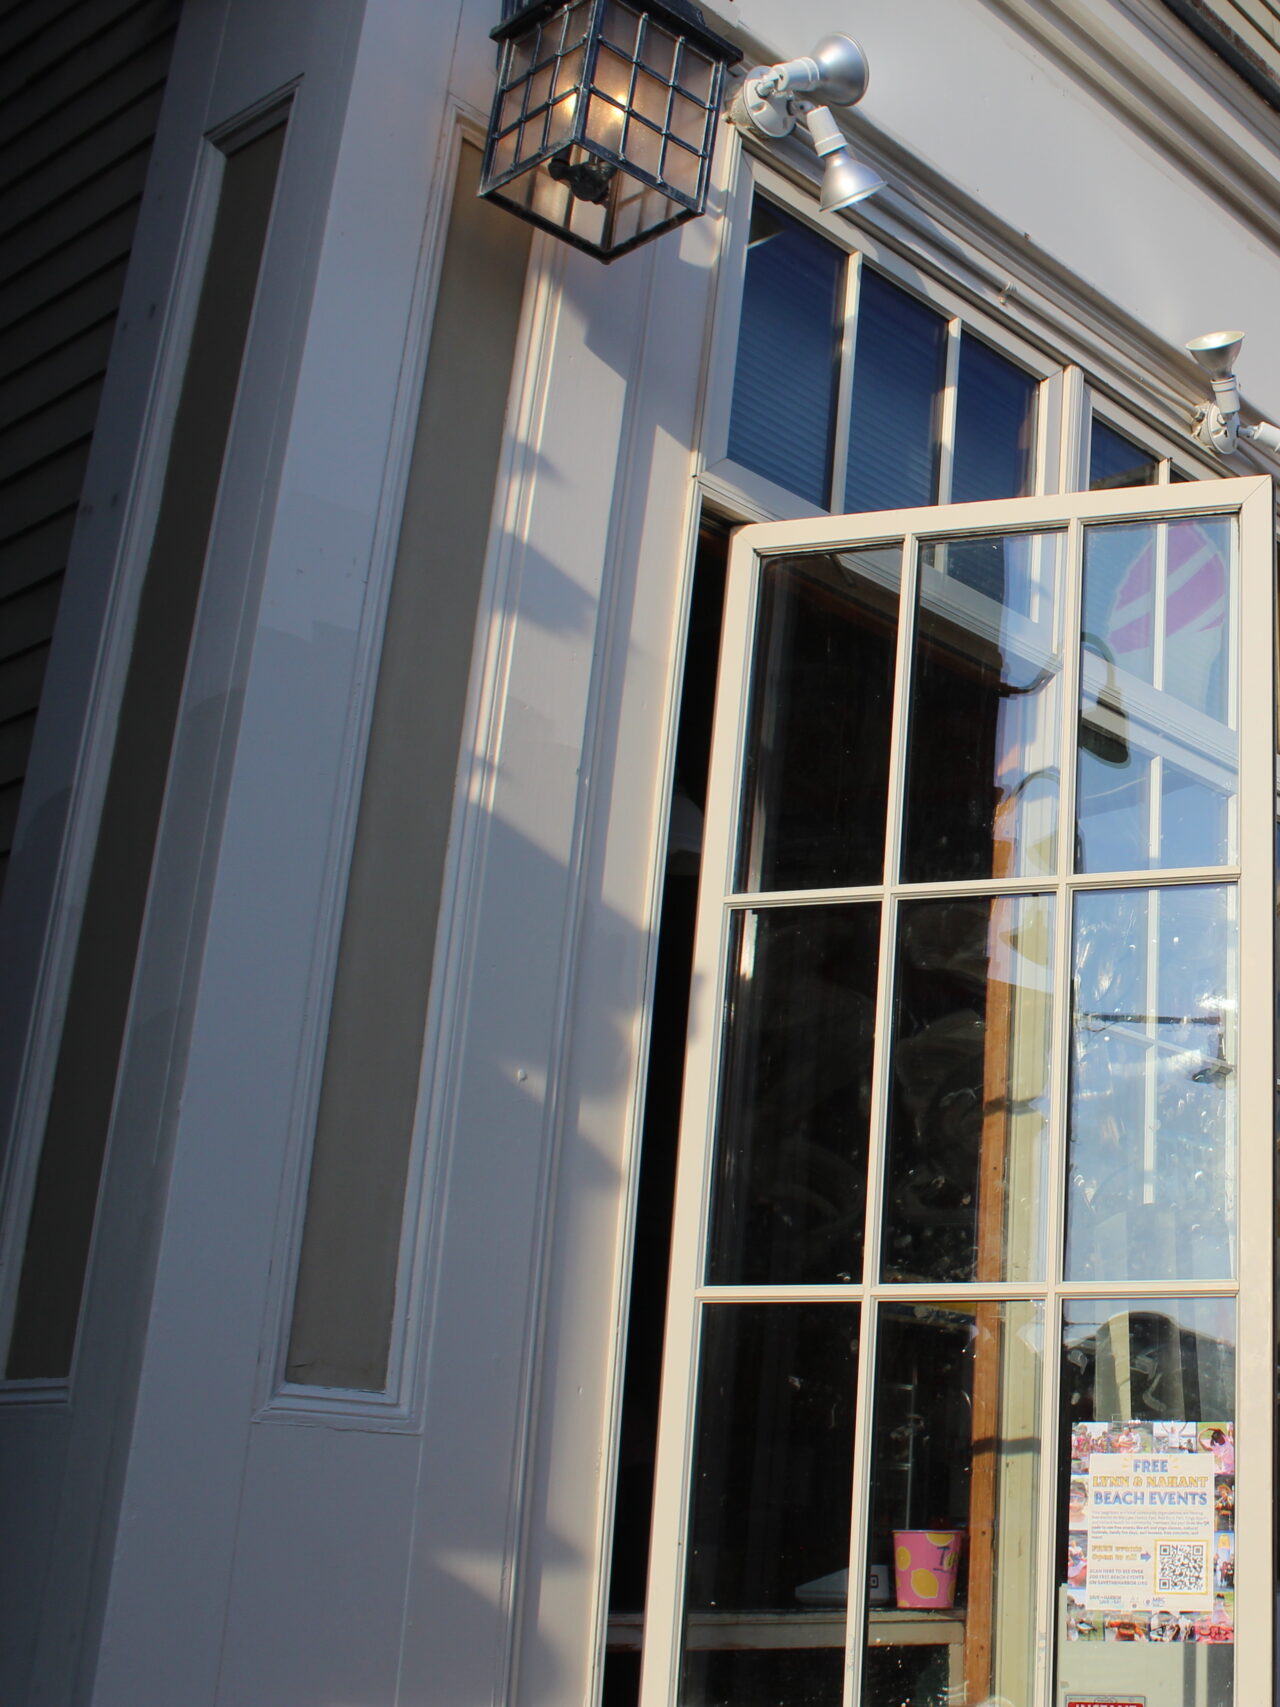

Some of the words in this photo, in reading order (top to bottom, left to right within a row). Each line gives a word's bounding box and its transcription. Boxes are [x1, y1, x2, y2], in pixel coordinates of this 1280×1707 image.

[1133, 1459, 1168, 1472] FREE
[1092, 1476, 1129, 1488] LYNN
[1133, 1476, 1143, 1487] &
[1147, 1476, 1208, 1488] NAHANT
[1094, 1492, 1145, 1505] BEACH
[1150, 1492, 1207, 1505] EVENTS
